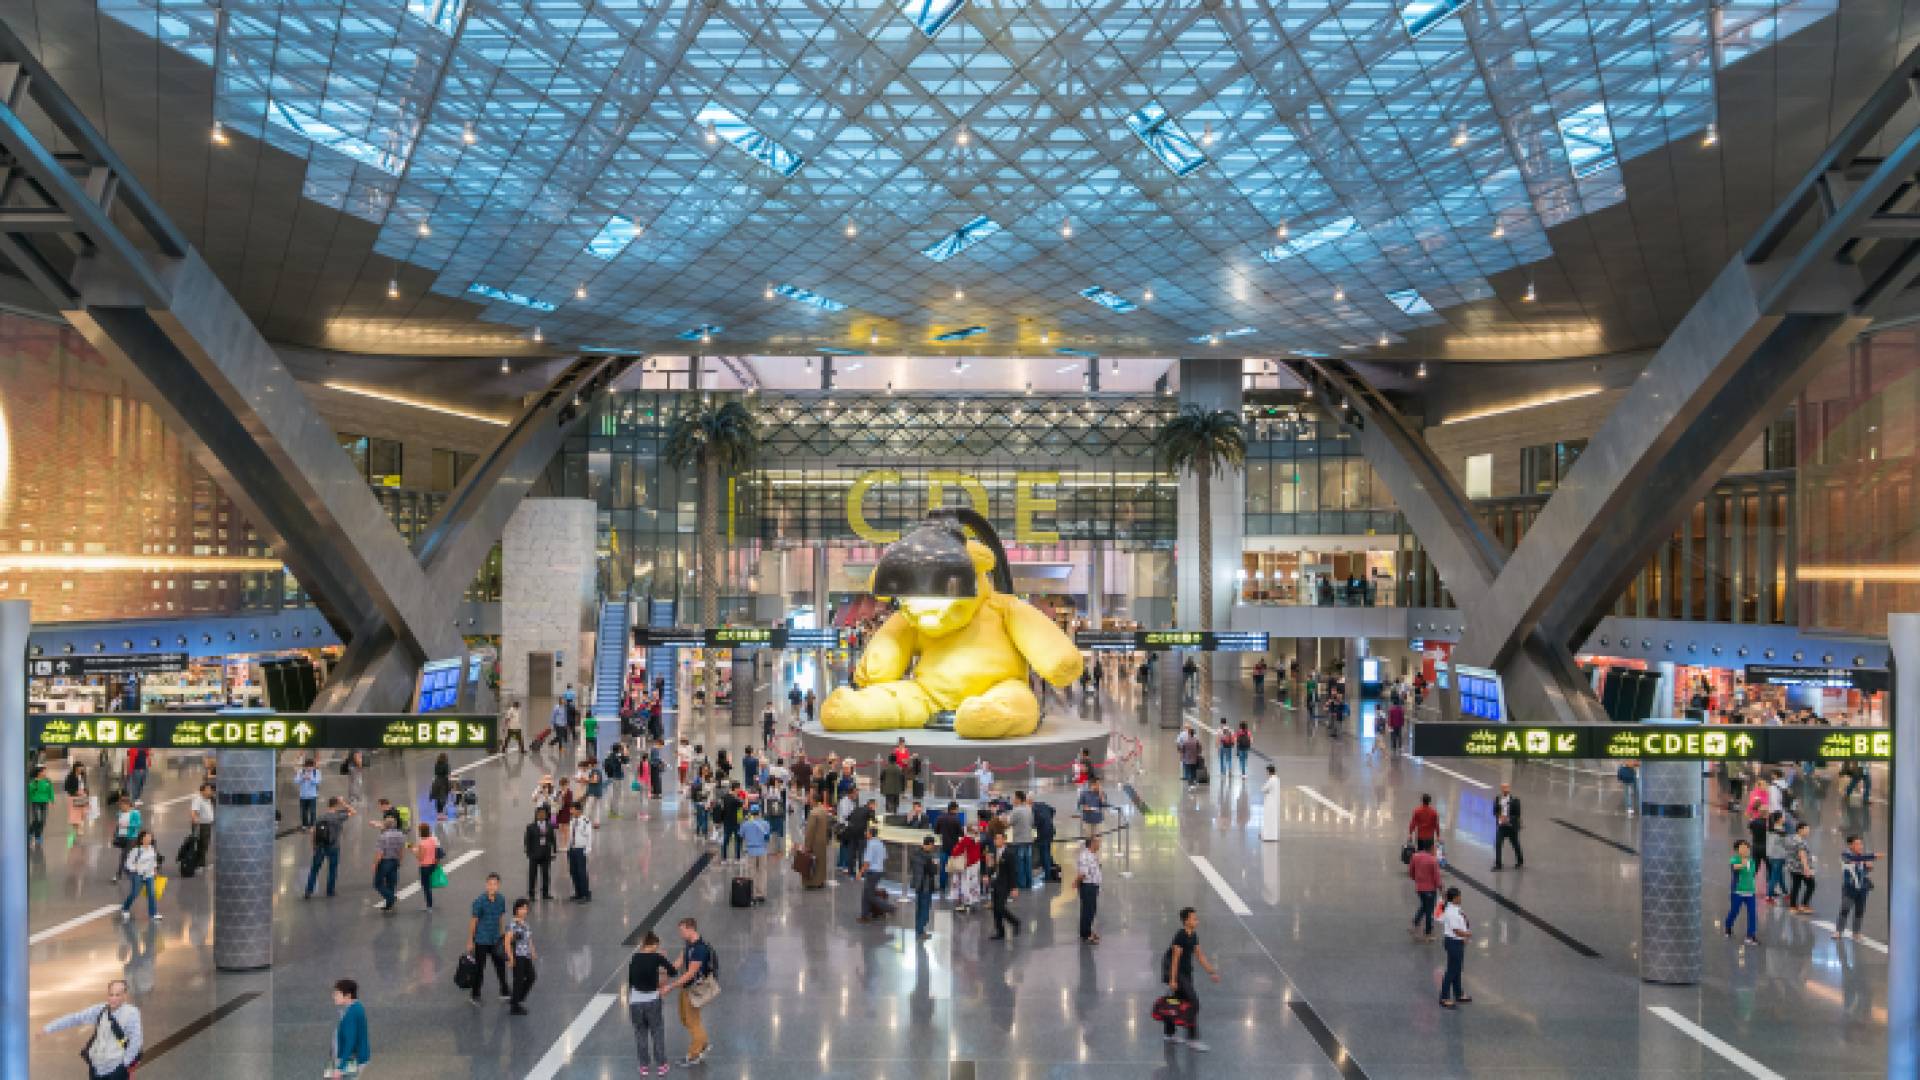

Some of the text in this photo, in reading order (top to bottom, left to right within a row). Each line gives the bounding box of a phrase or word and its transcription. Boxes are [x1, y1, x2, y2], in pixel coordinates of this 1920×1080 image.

[75, 721, 92, 741] A
[205, 723, 260, 742] CDE
[418, 723, 432, 742] B
[1501, 731, 1520, 751] A
[1644, 733, 1699, 753] CDE
[1854, 734, 1869, 753] B
